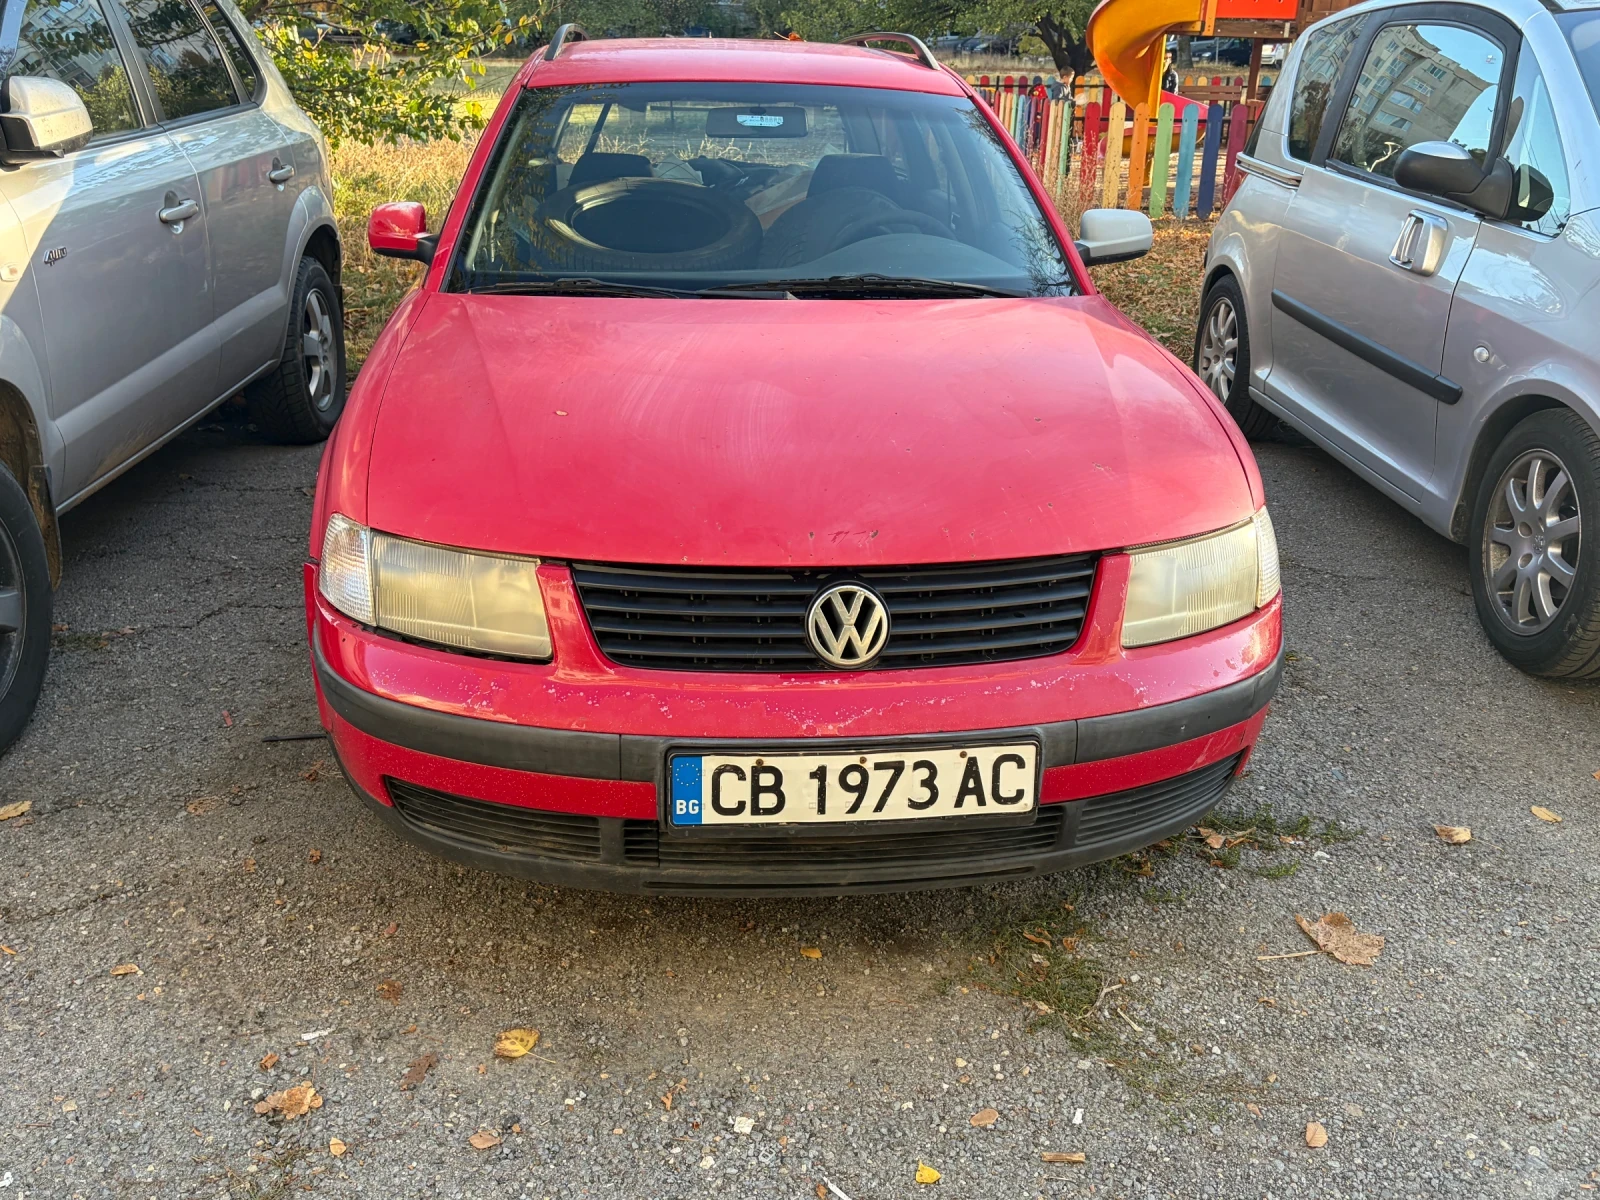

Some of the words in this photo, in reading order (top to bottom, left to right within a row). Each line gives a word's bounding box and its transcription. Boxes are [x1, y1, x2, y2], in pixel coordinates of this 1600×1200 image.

[711, 764, 786, 816] CB
[809, 760, 939, 815] 1973
[953, 753, 1026, 808] AC
[676, 799, 699, 815] BG
